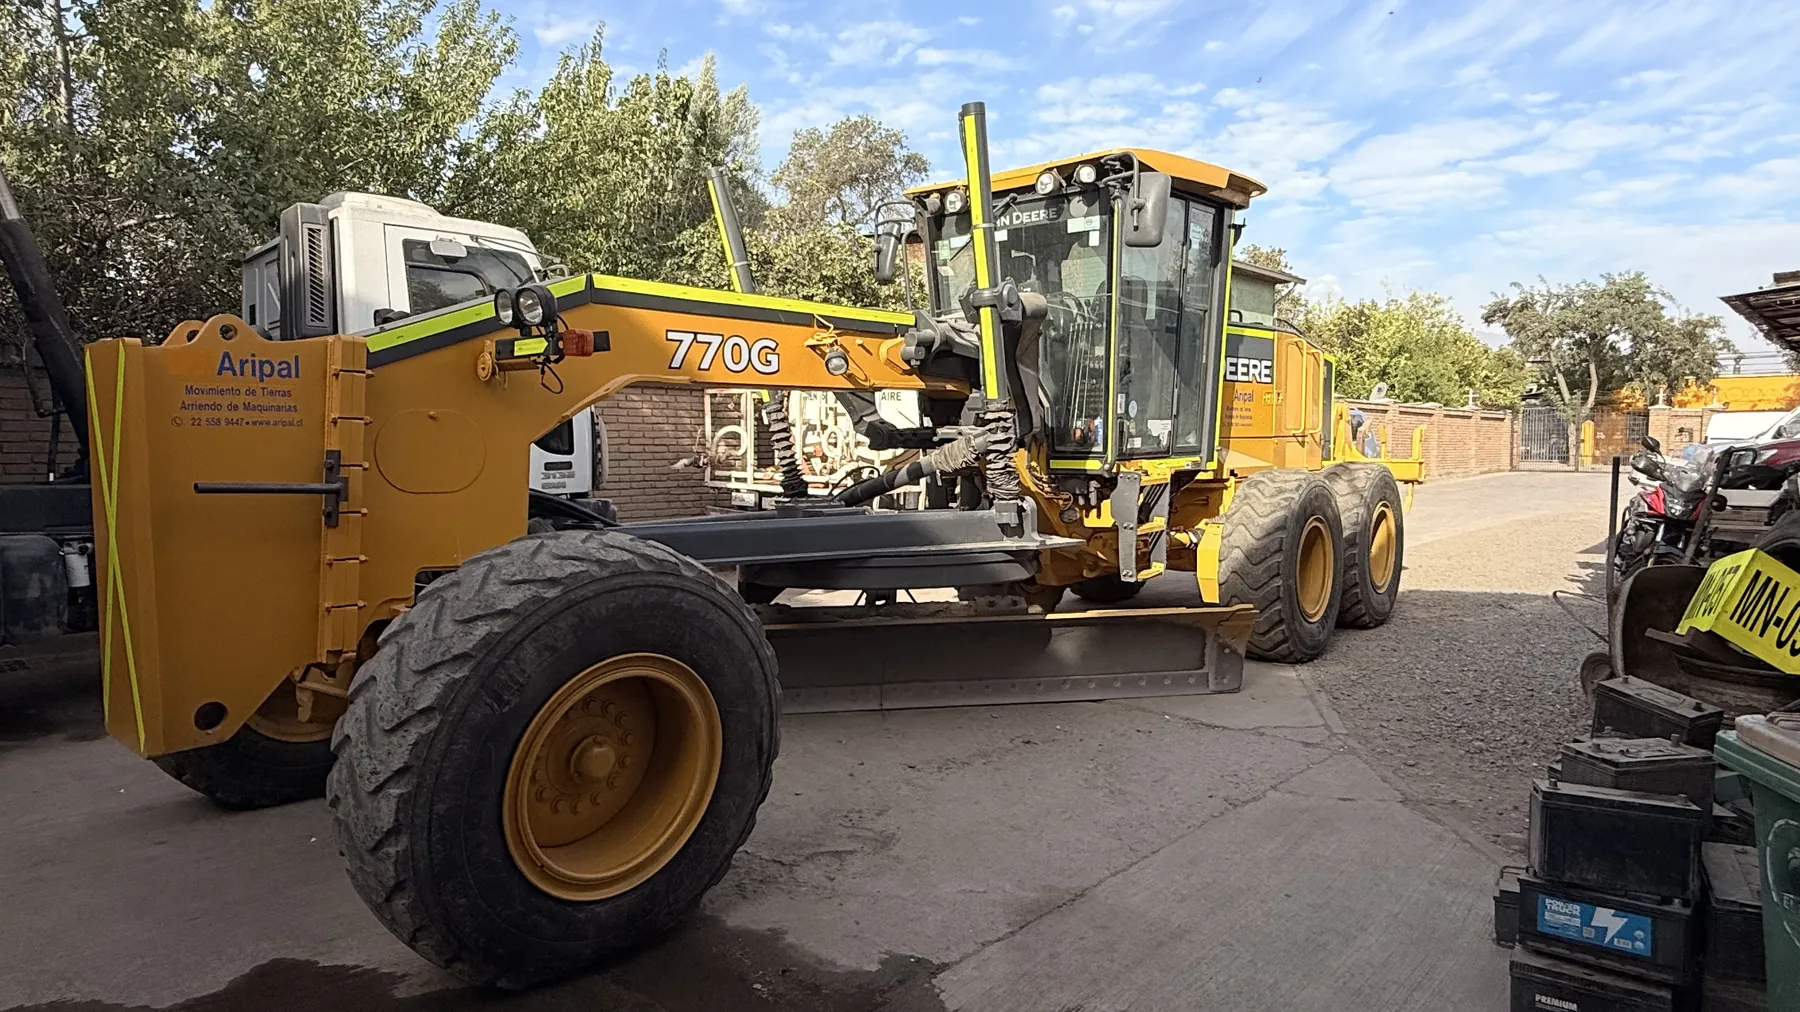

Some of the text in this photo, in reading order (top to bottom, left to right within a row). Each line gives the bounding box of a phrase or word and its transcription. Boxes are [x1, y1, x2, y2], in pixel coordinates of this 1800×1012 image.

[1012, 207, 1058, 225] DEERE
[665, 329, 780, 375] 770G
[216, 351, 300, 382] Aripal
[1225, 357, 1272, 383] EERE
[184, 385, 292, 397] Movimiento de Tierras
[180, 400, 298, 413] Arriendo de Maquinarias
[190, 417, 202, 426] 22
[205, 417, 221, 427] 558
[224, 418, 244, 427] 9447
[1535, 994, 1578, 1012] PREMIUM
